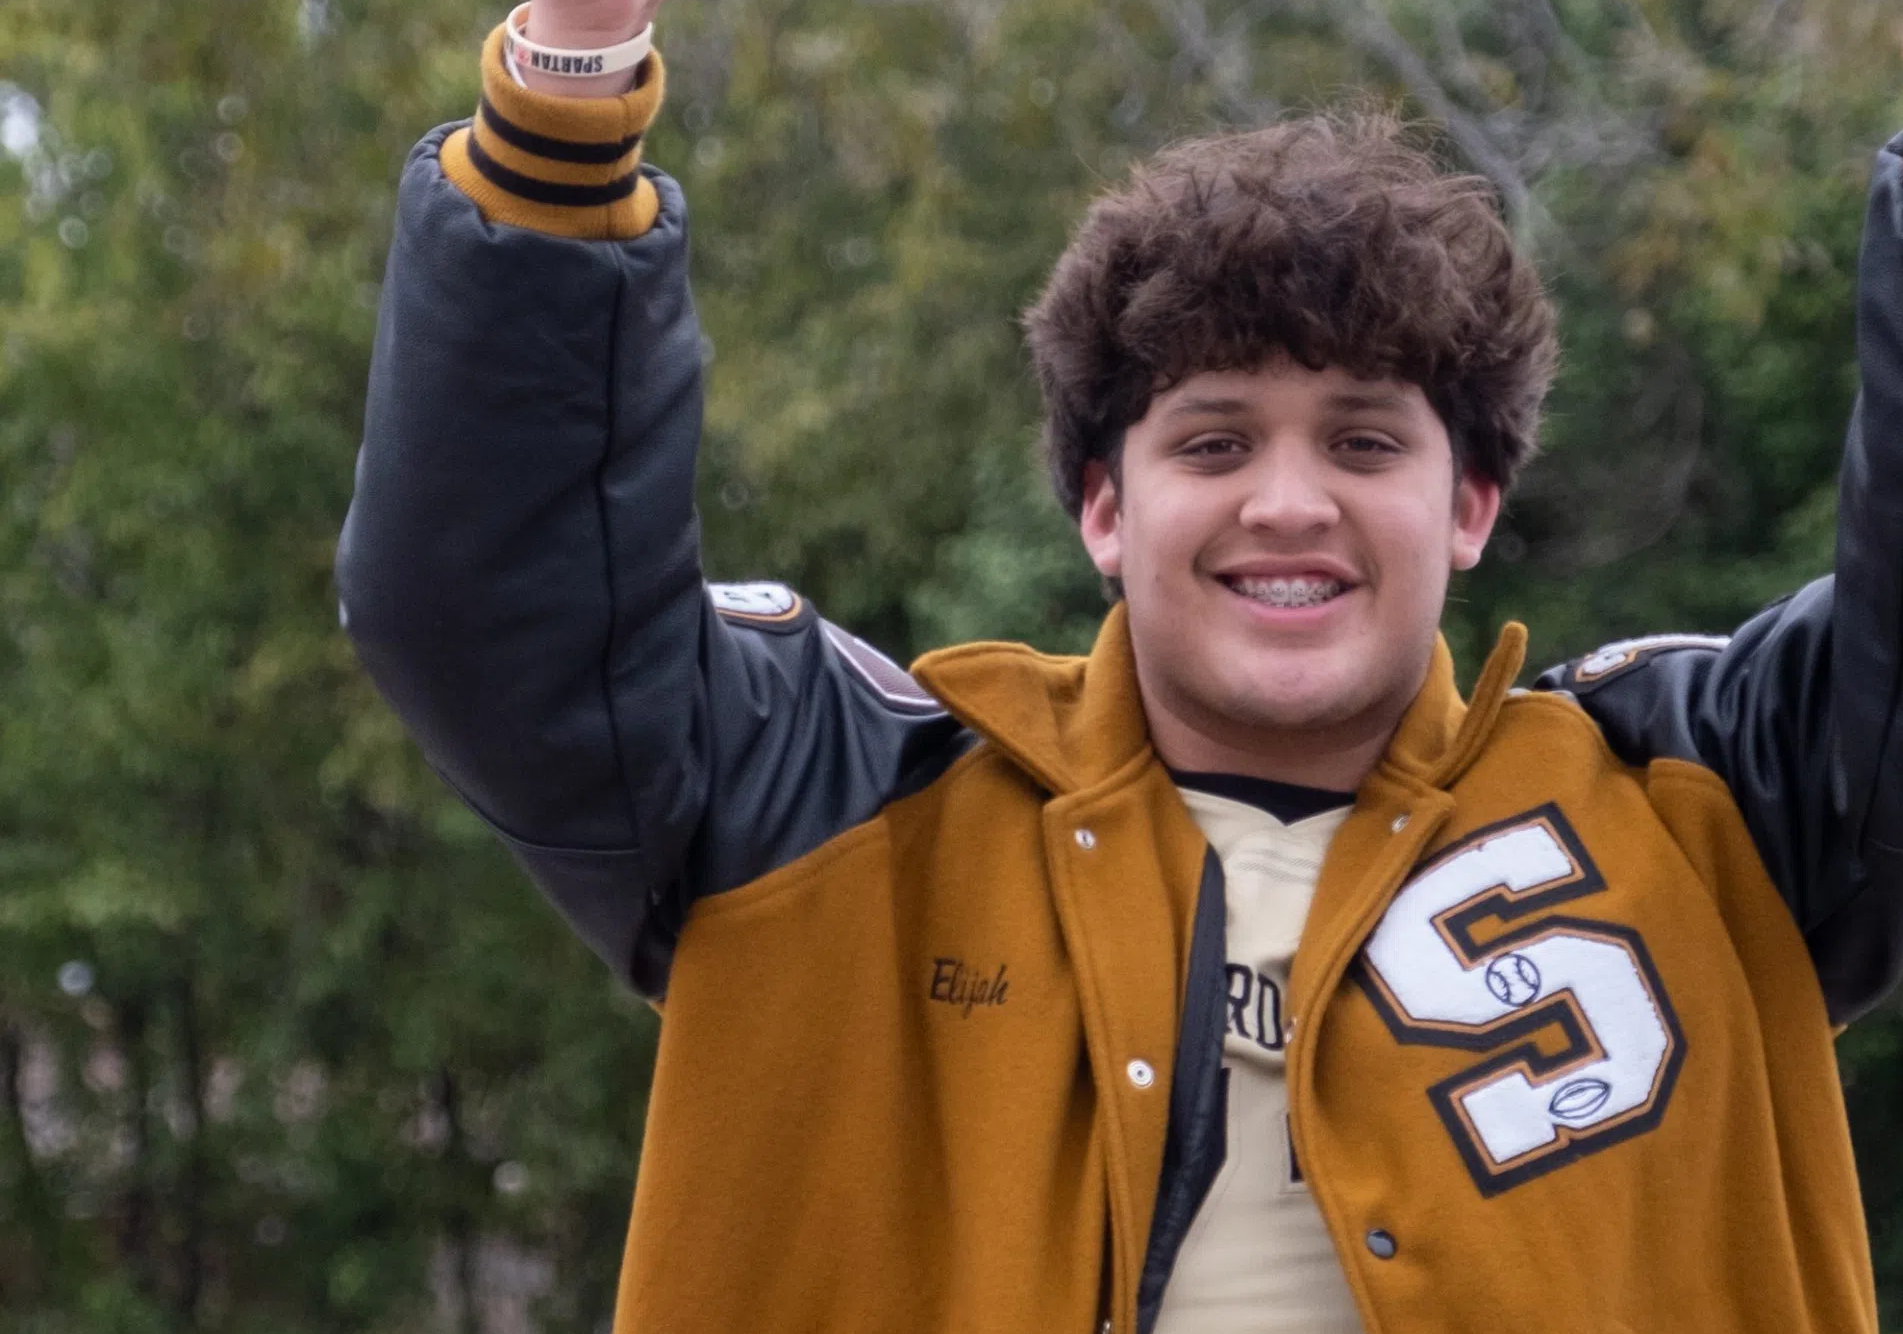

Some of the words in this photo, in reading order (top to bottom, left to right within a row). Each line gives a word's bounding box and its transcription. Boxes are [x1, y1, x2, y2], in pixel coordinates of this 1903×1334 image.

[531, 50, 603, 73] SPARTAN
[930, 957, 1009, 1019] Elijah
[1350, 781, 1687, 1199] S
